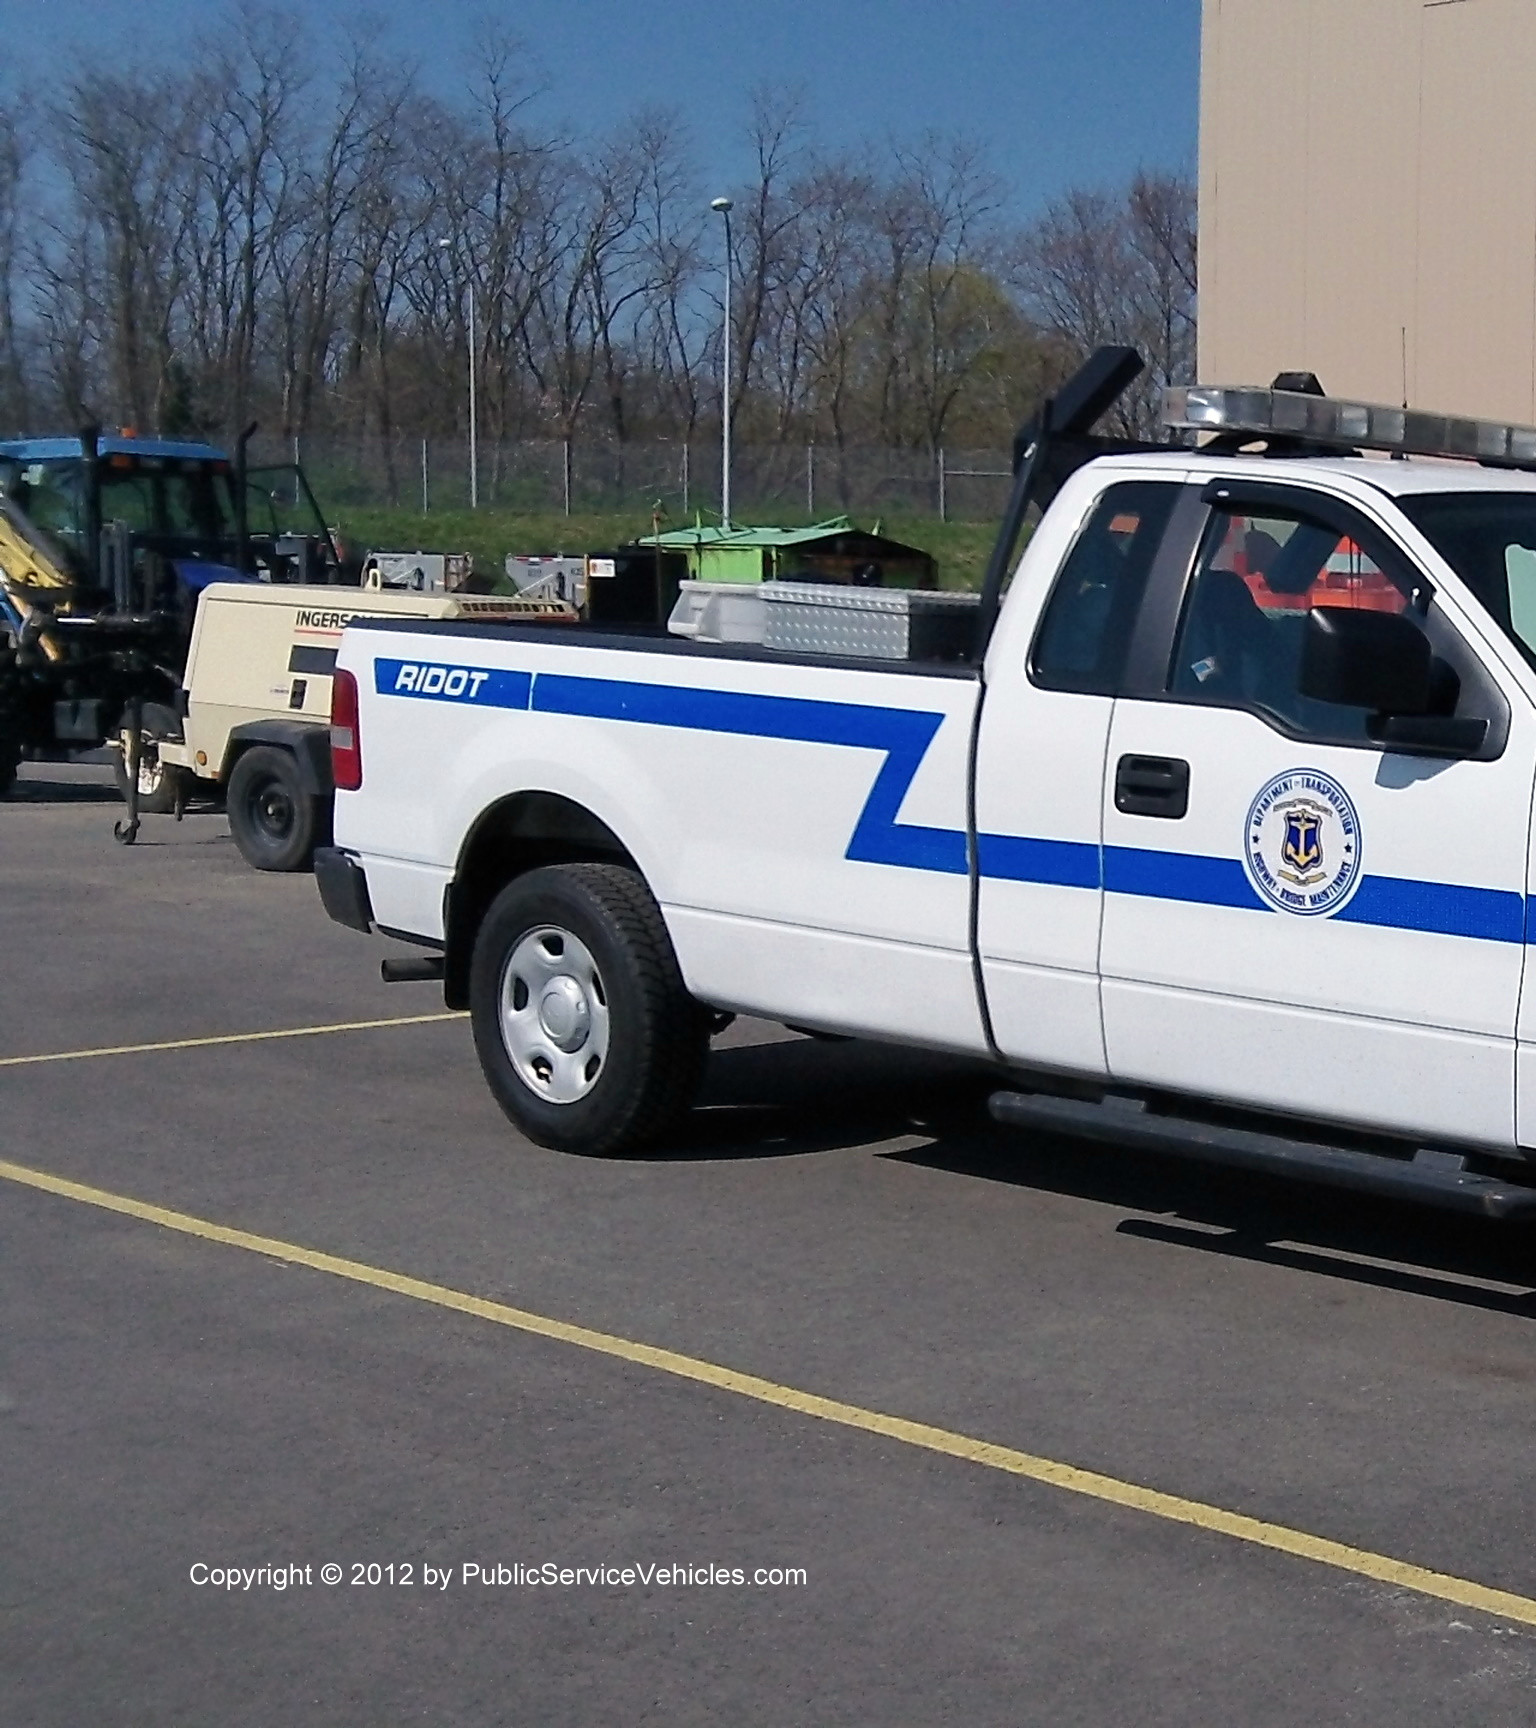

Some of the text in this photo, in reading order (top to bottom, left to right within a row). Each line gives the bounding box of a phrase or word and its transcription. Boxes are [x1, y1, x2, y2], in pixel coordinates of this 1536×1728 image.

[296, 609, 359, 629] INGERS
[394, 664, 489, 698] RIDOT
[1253, 777, 1353, 836] DEPARTMENT TRANSPORTATION
[1309, 860, 1352, 906] MAINTENANCE
